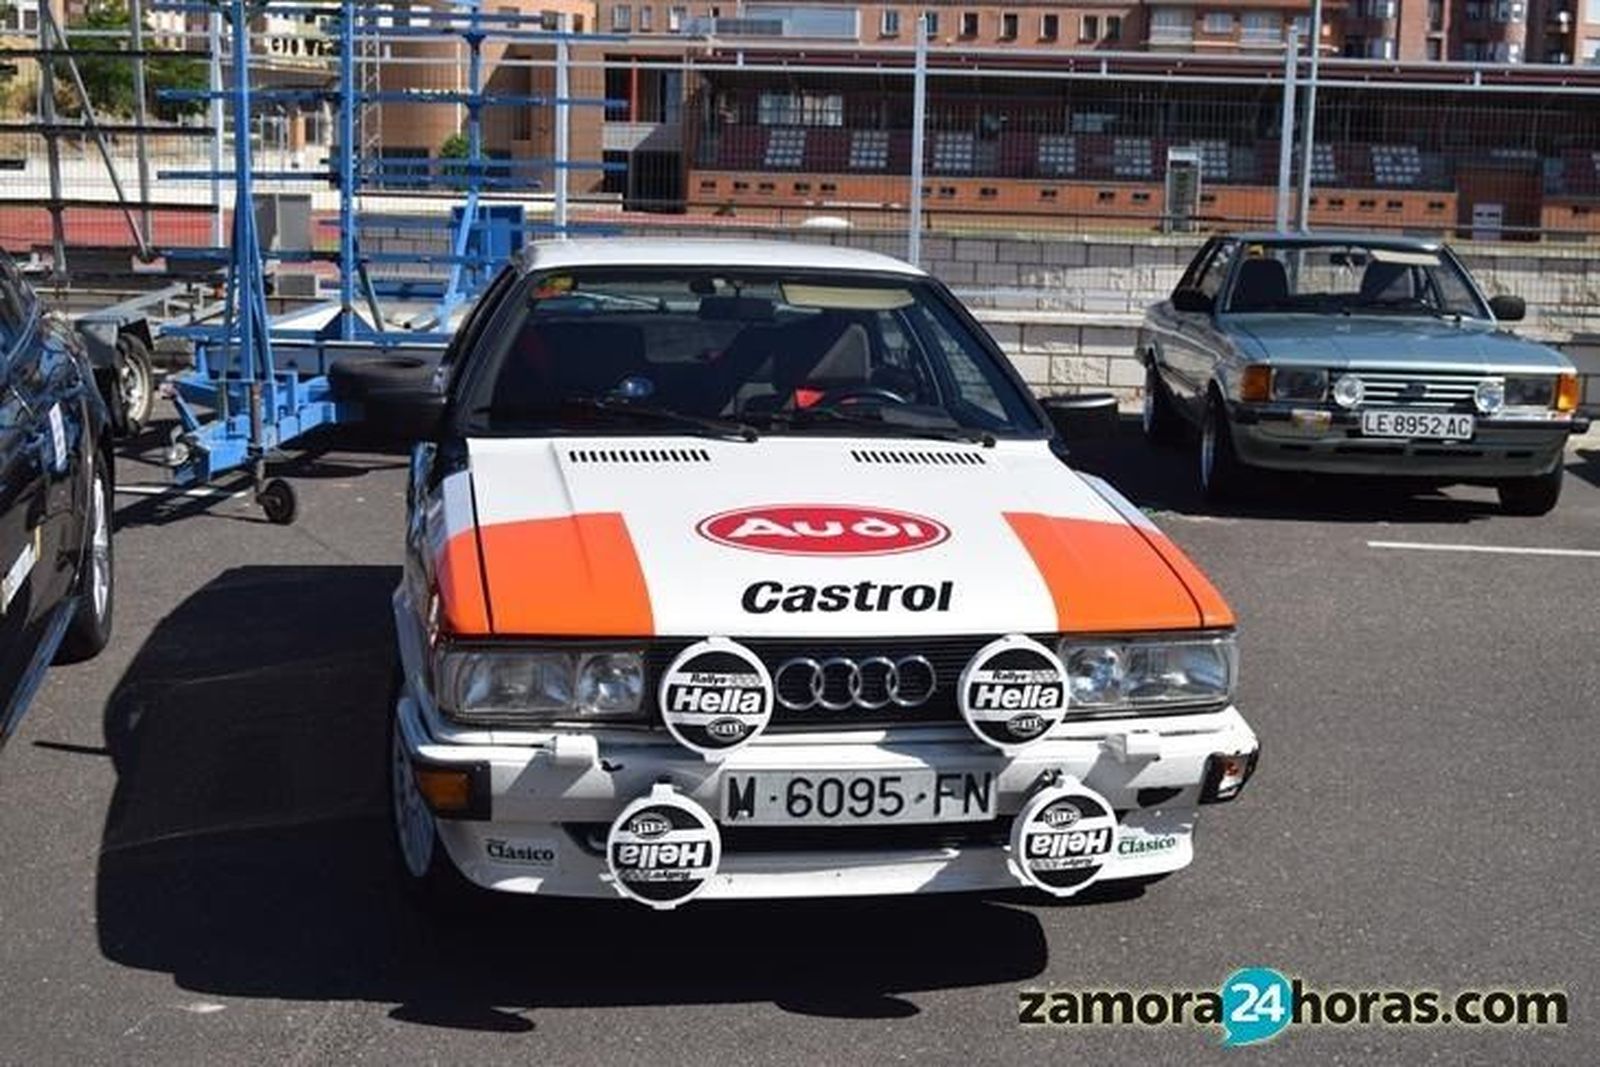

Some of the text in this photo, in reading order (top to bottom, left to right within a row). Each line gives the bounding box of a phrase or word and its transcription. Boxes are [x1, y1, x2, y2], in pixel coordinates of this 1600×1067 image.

[740, 580, 954, 614] Castrol
[673, 686, 762, 713] Hella
[974, 684, 1060, 709] Hella
[618, 842, 706, 869] Hella
[1030, 829, 1108, 858] Hella
